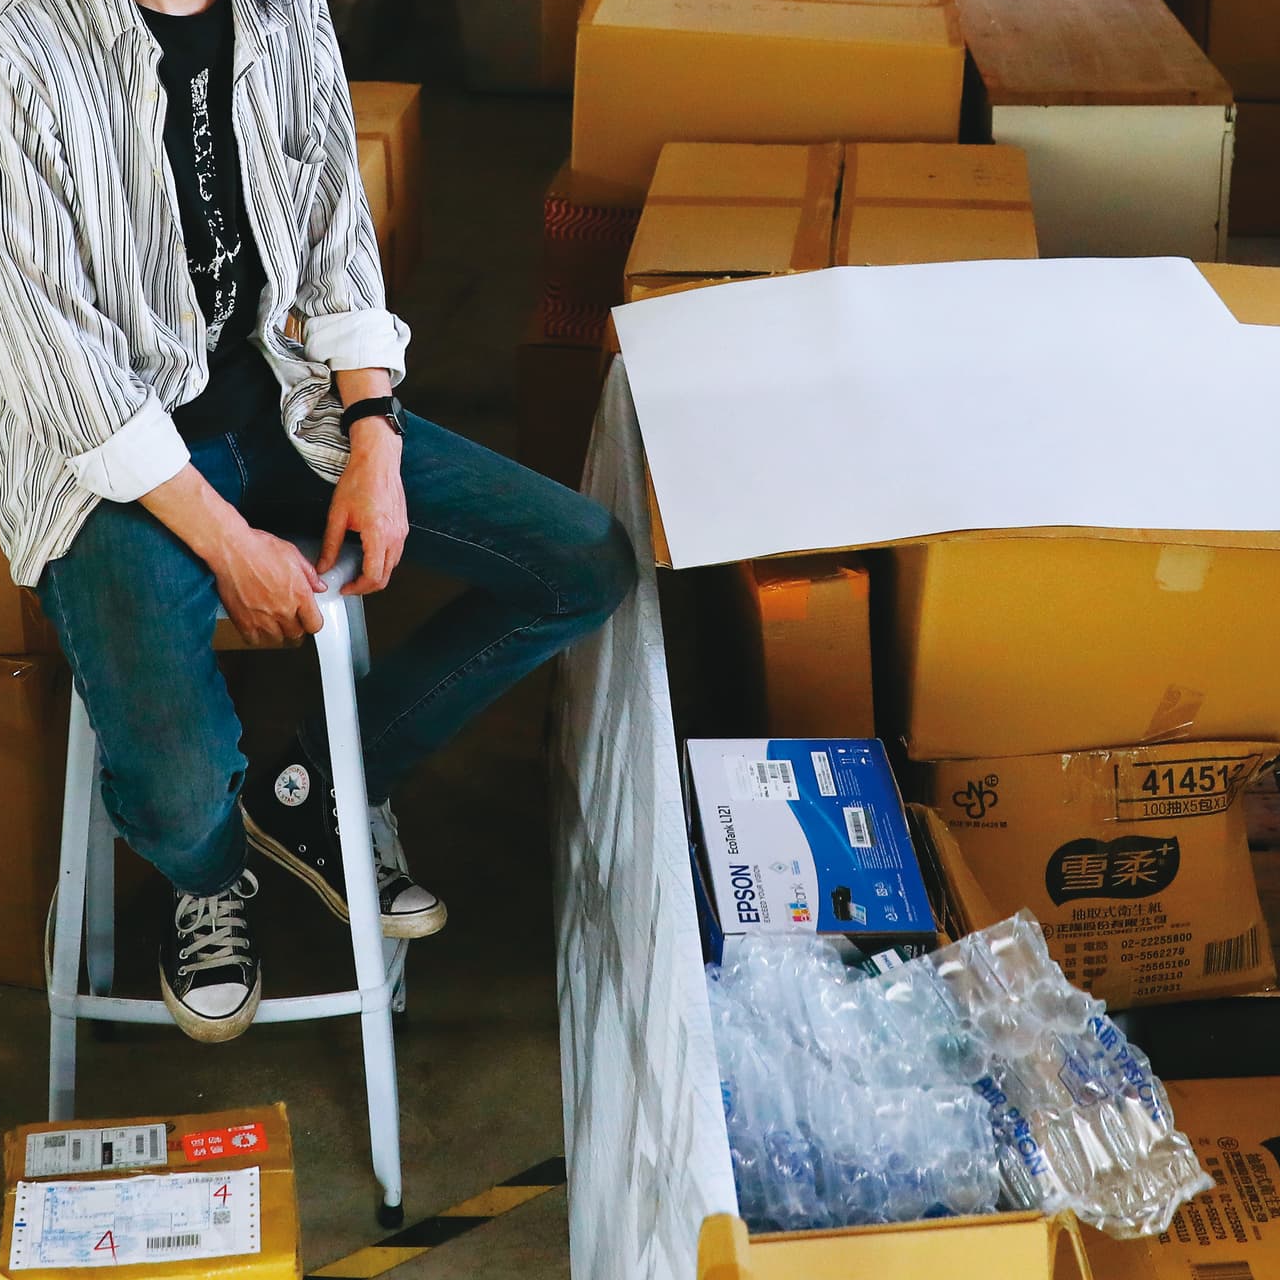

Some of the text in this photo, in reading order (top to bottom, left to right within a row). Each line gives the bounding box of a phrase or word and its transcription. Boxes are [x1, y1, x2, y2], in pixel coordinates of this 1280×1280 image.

[723, 824, 740, 855] EcoTank
[728, 863, 761, 924] EPSON
[1088, 1016, 1118, 1051] AIR
[213, 1183, 233, 1207] 4
[93, 1229, 120, 1265] 4
